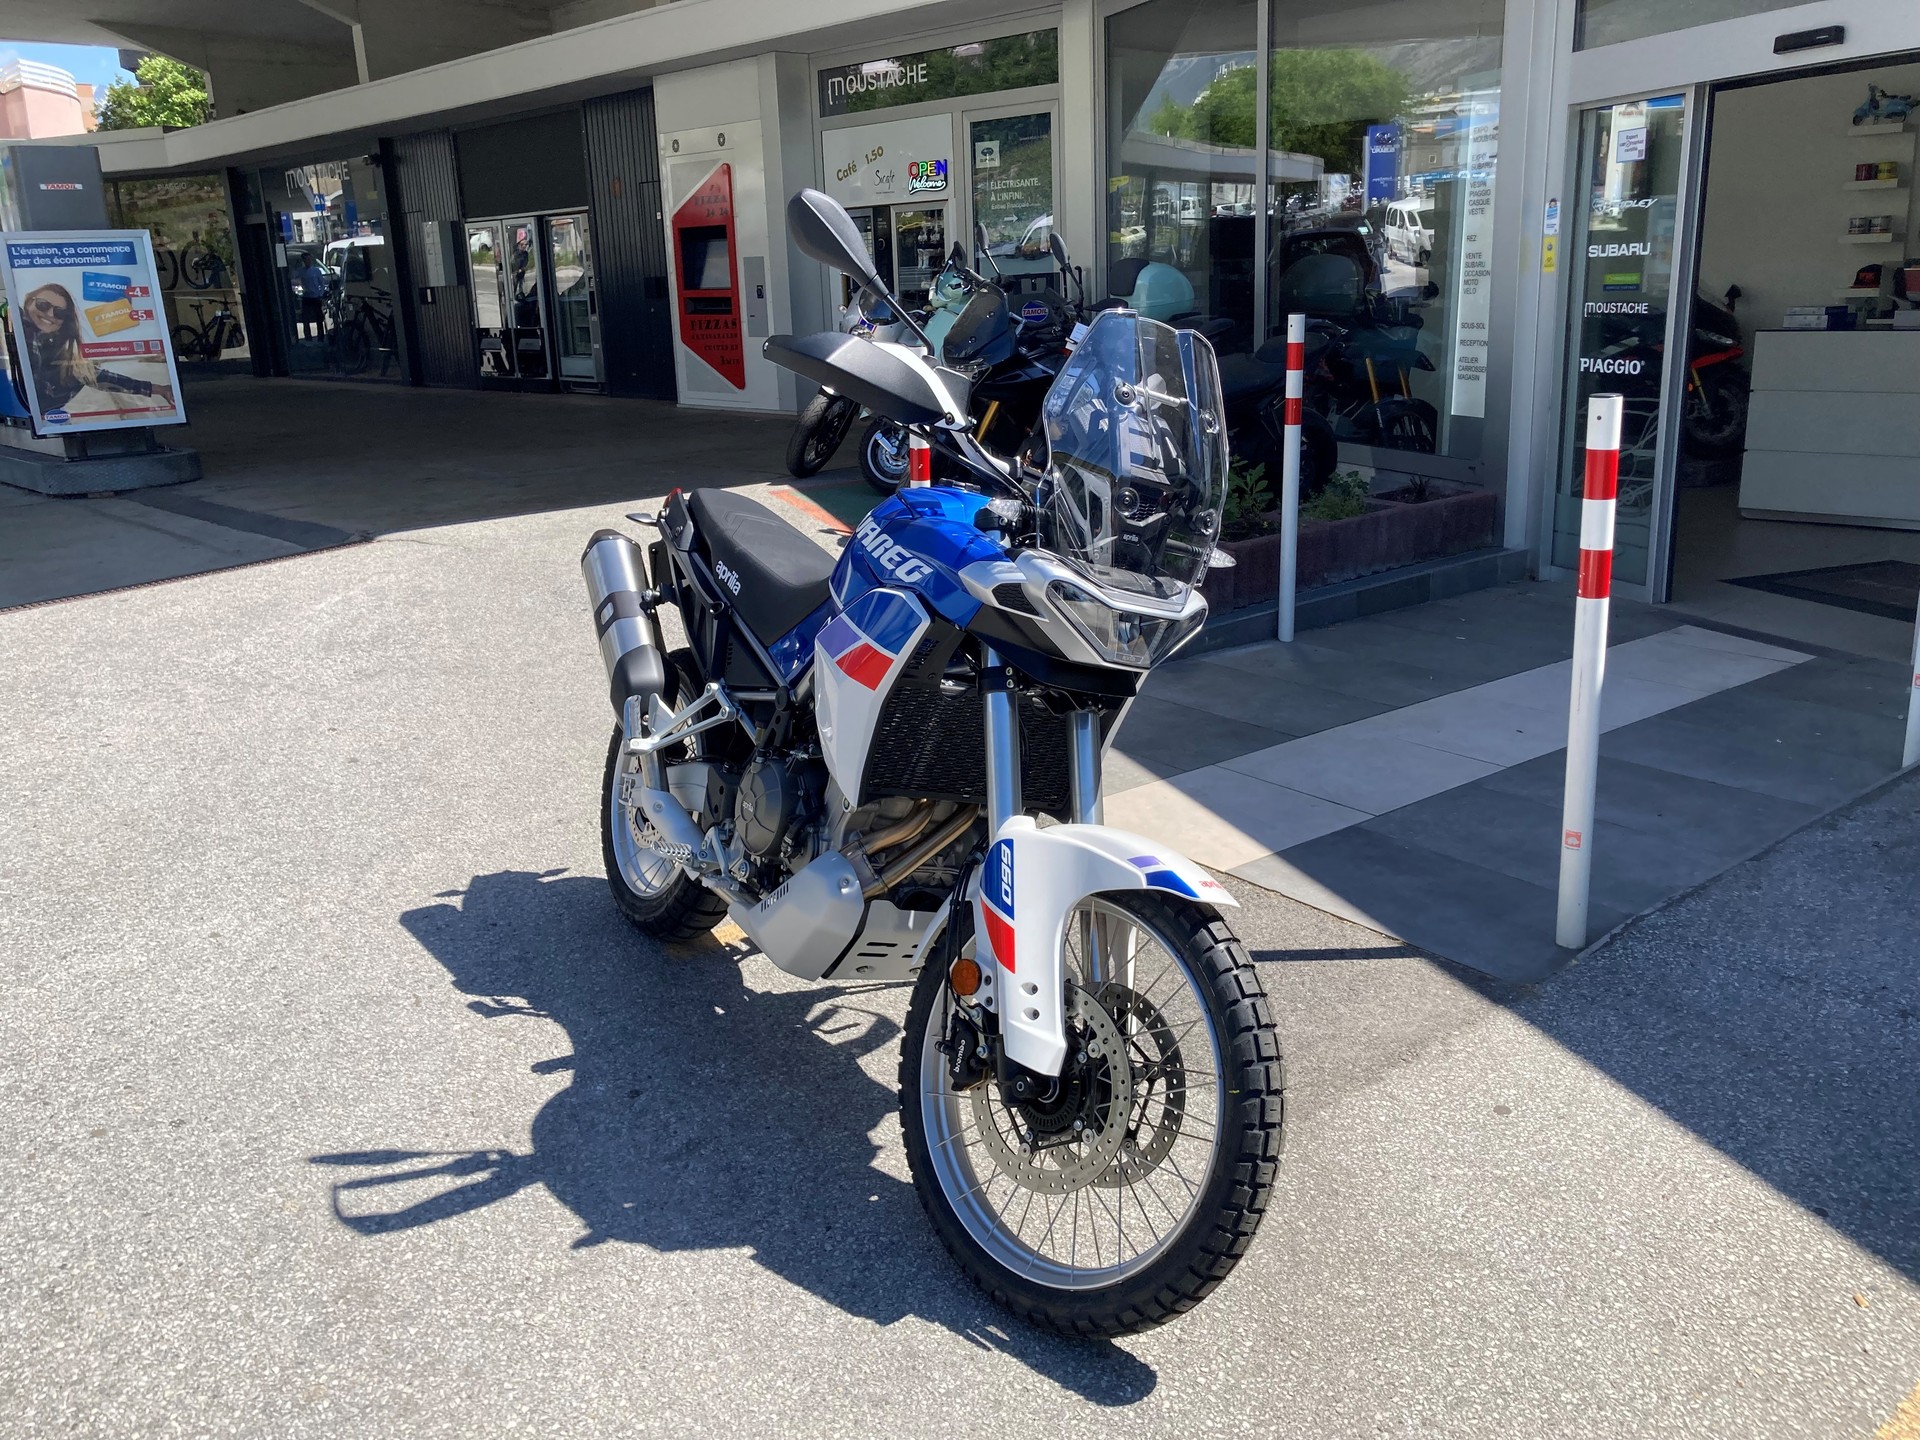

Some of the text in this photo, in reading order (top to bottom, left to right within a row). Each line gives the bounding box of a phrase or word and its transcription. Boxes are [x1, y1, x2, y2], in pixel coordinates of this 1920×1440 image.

[828, 63, 928, 105] MOUSTACHE
[865, 146, 884, 164] 1.50
[836, 161, 858, 181] Café
[908, 159, 948, 177] OPEN
[285, 161, 350, 198] MOUSTACHE
[908, 176, 947, 194] Welcome
[1468, 198, 1491, 206] CASQUE
[1469, 189, 1491, 197] PIAGGIO
[11, 245, 131, 256] L'évasion, ça commence
[1588, 242, 1651, 257] SUBARU
[14, 258, 31, 267] par
[33, 256, 51, 265] des
[101, 308, 130, 319] TAMOIL
[1584, 303, 1648, 317] MOUSTACHE
[691, 318, 737, 330] PIZZAS
[1580, 358, 1641, 374] PIAGGIO
[856, 509, 934, 583] UAREG
[715, 560, 741, 596] aprilia
[1001, 842, 1012, 907] 660
[953, 1039, 966, 1073] brembo
